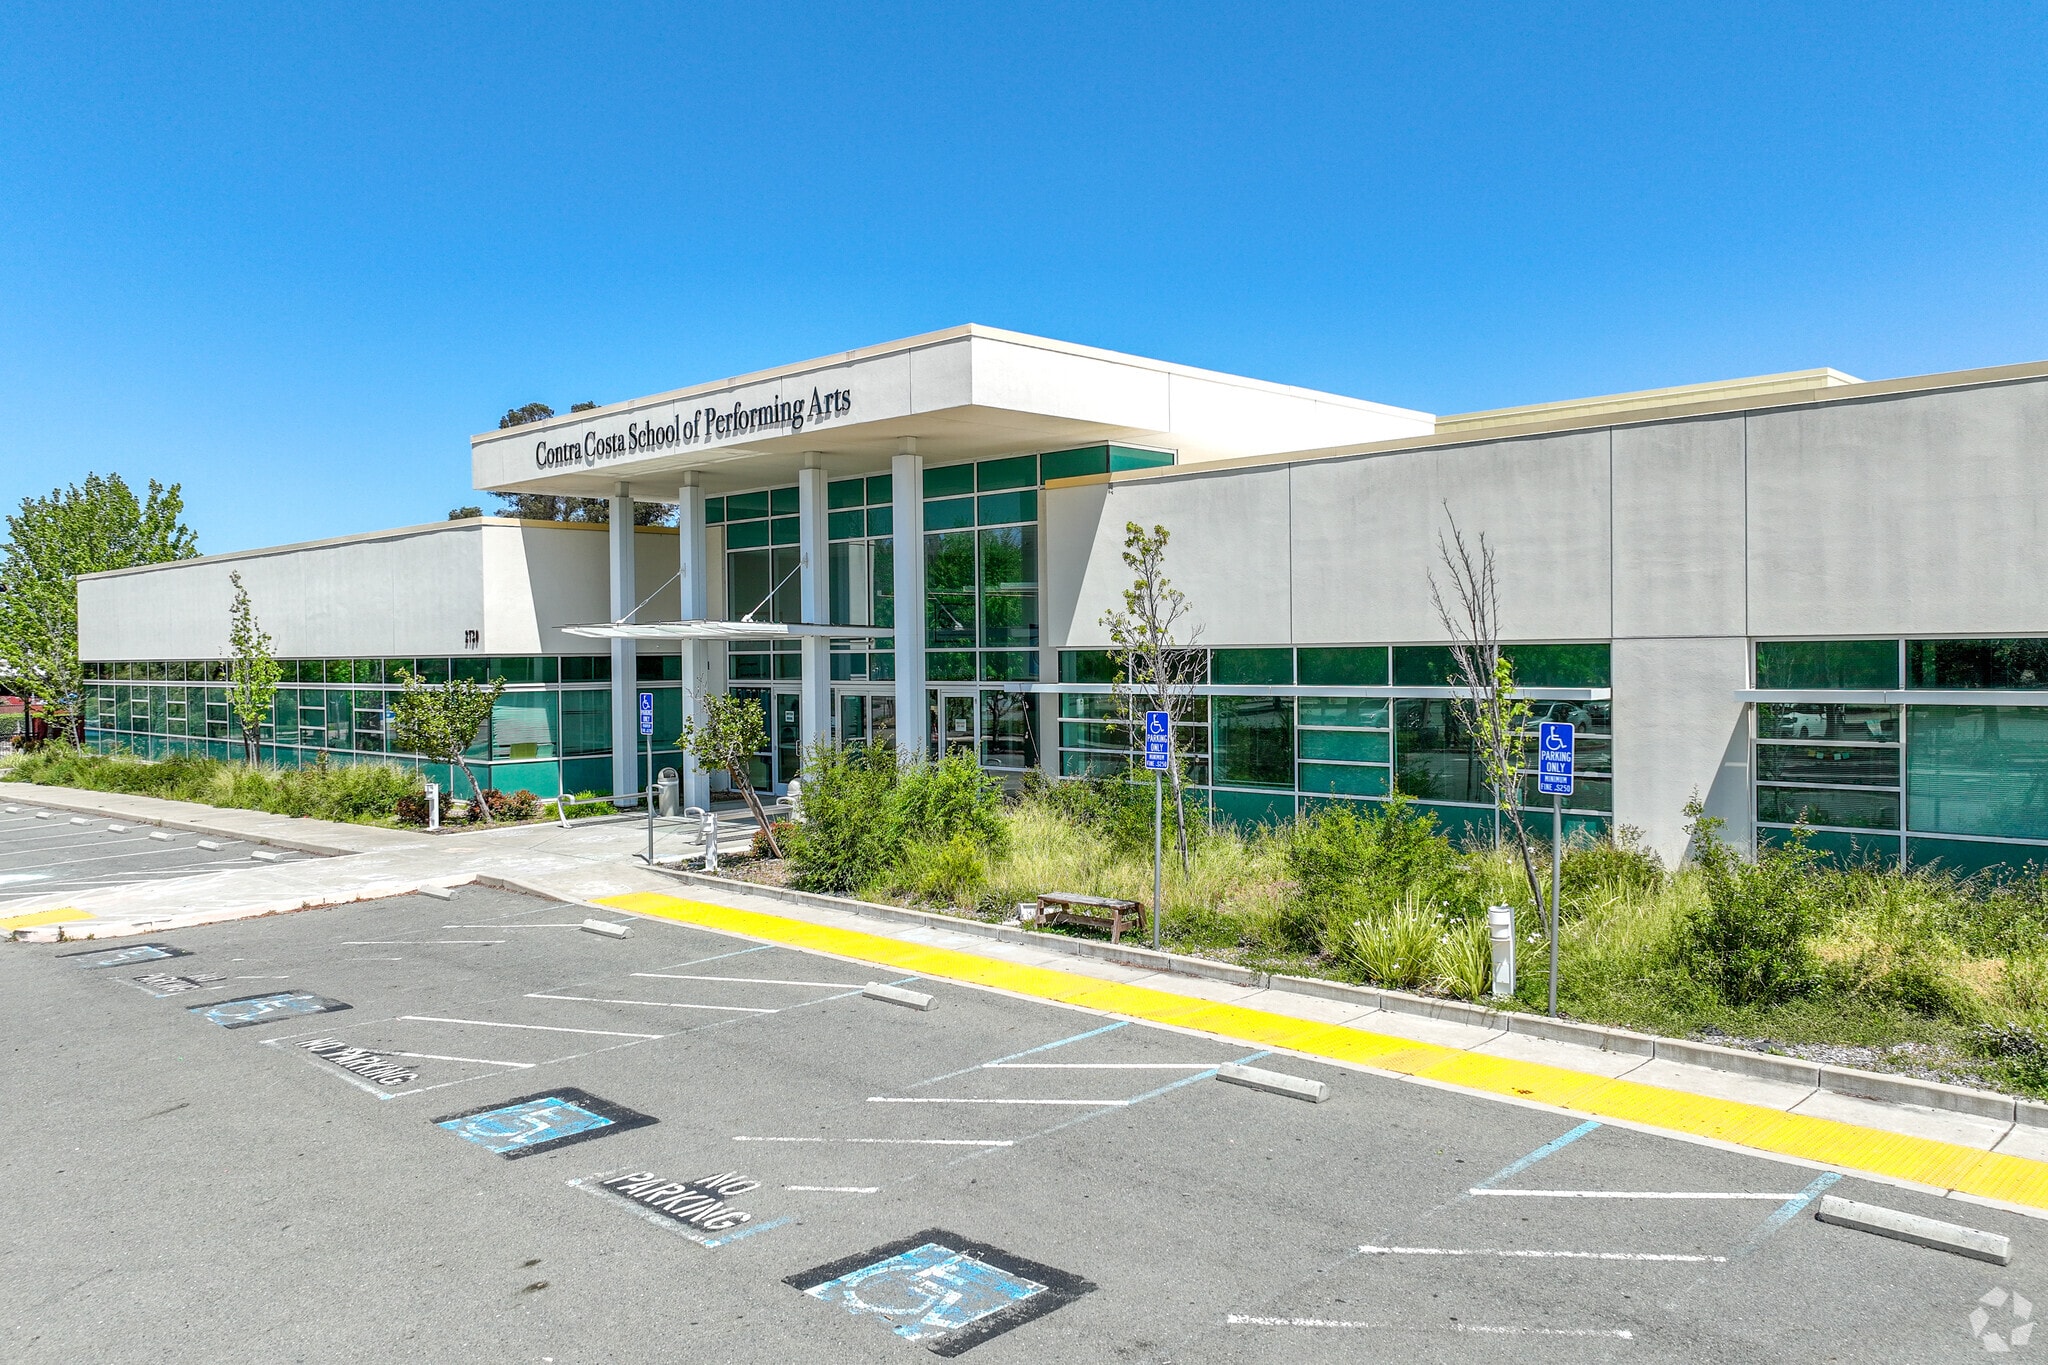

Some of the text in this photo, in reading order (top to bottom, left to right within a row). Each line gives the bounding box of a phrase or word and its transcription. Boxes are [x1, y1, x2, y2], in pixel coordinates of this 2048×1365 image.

[535, 386, 852, 466] Contra Costa School of Performing Arts
[1541, 750, 1572, 762] PARKING
[1546, 762, 1566, 773] ONLY
[1540, 783, 1553, 791] FINE
[1544, 775, 1568, 784] MINIMUM
[321, 1047, 419, 1086] PARKING
[694, 1171, 761, 1196] NO
[603, 1171, 752, 1230] PARKING
